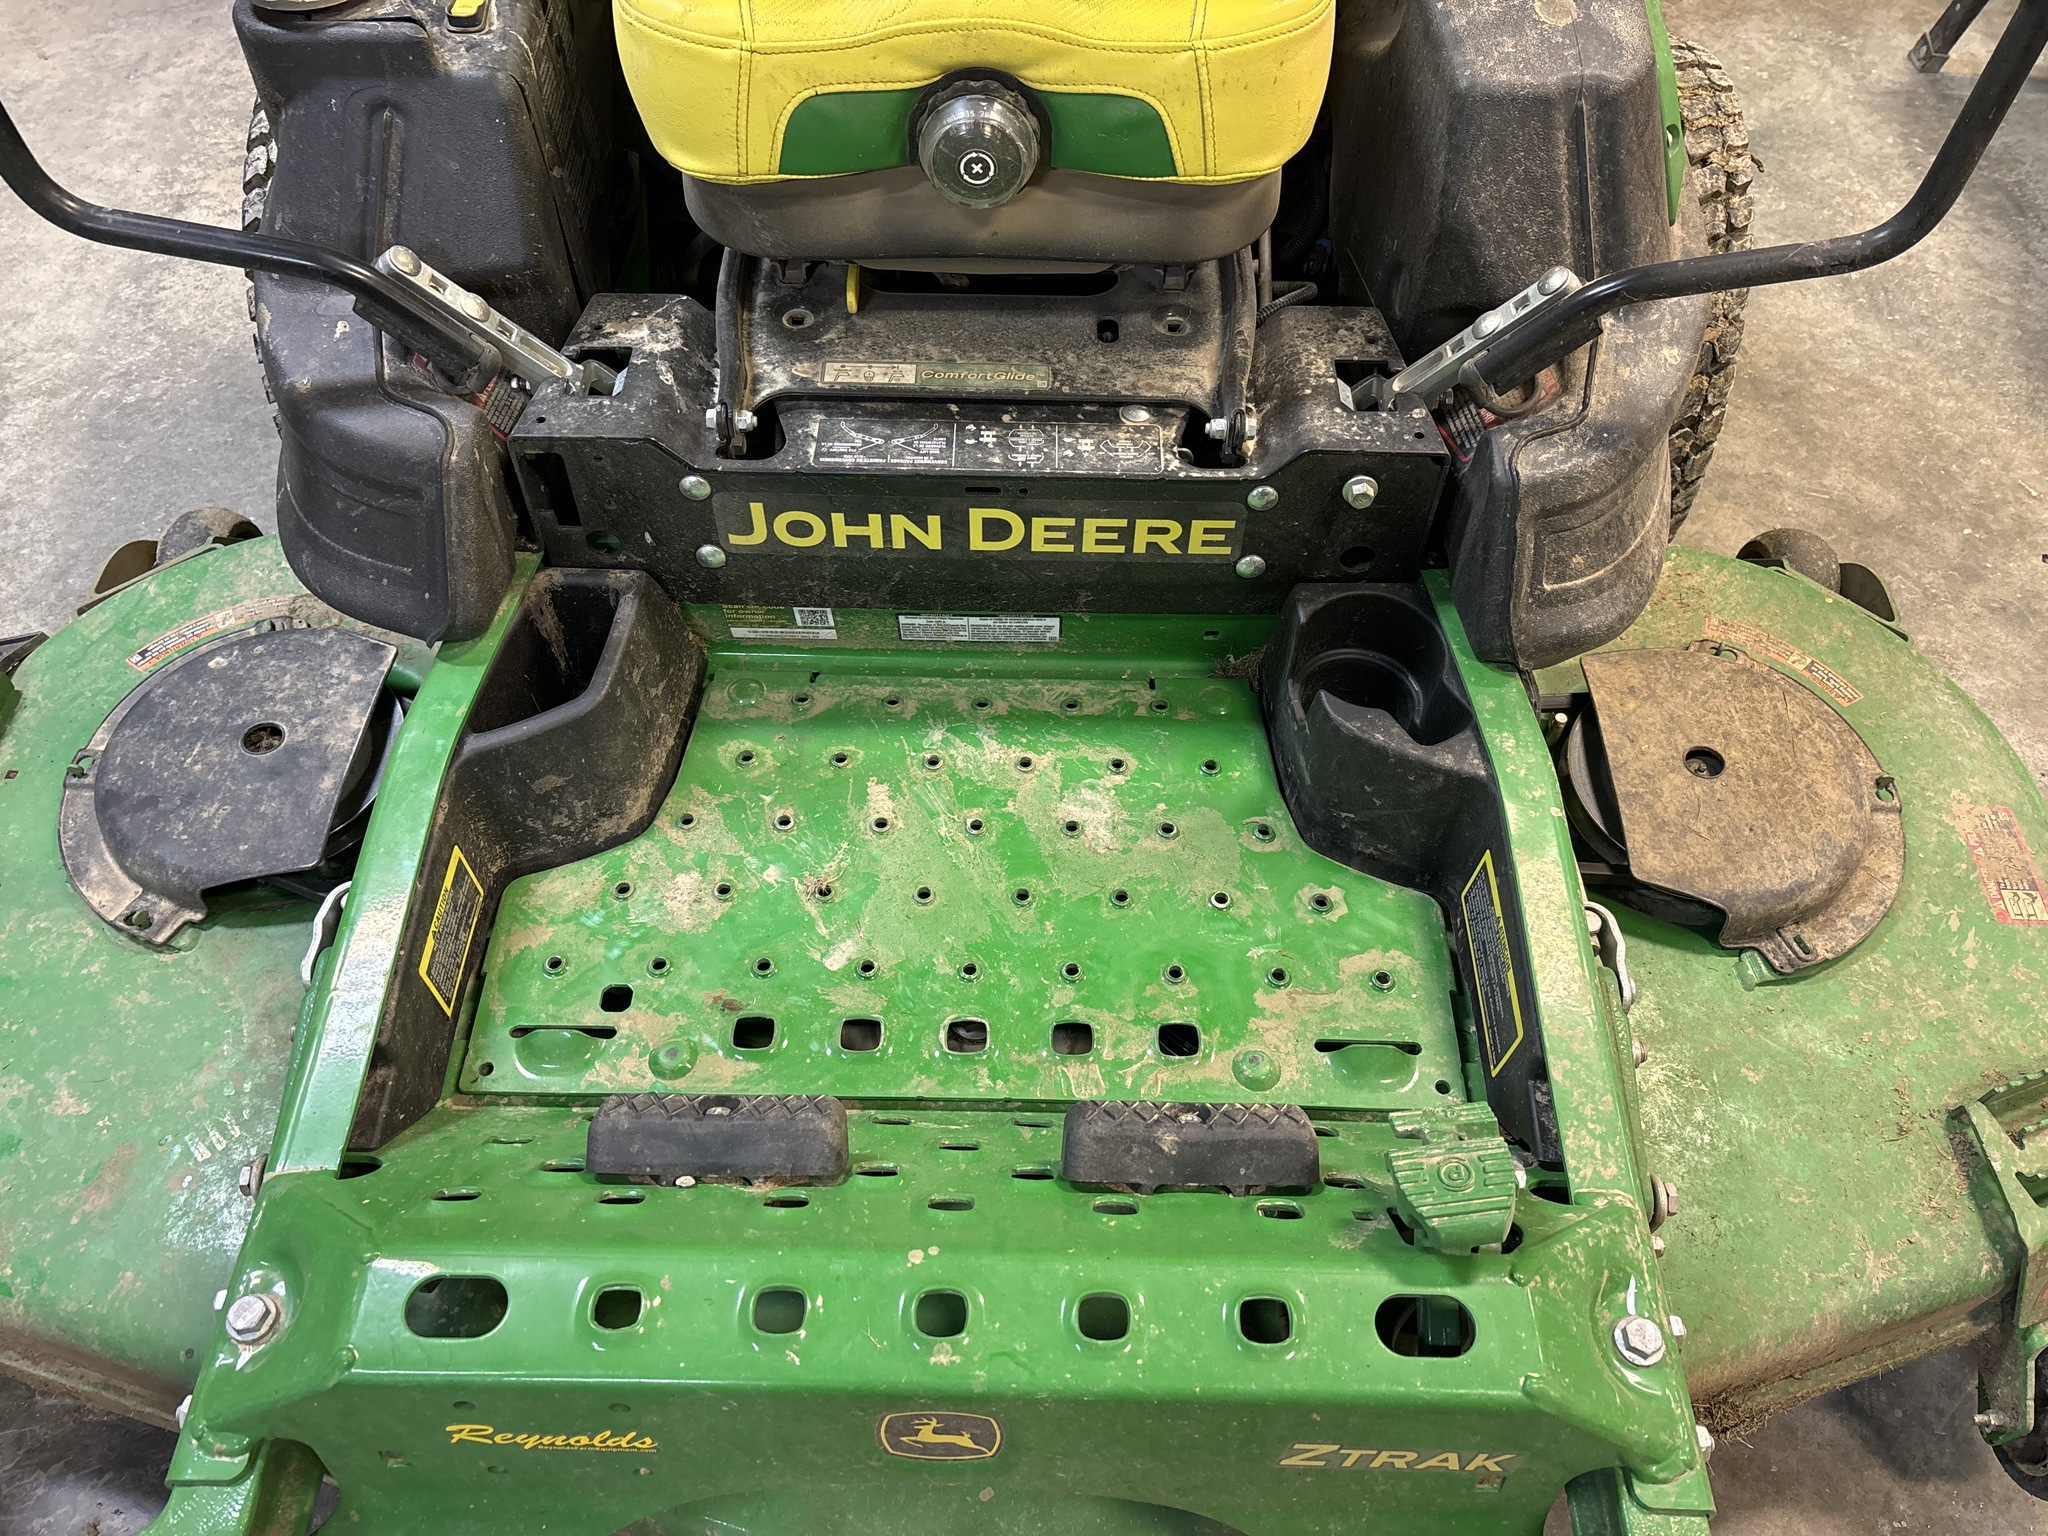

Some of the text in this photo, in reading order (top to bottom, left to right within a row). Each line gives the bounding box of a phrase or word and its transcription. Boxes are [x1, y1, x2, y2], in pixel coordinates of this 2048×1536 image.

[921, 370, 1038, 381] ComfortGlide
[727, 502, 1237, 556] JOHN DEERE
[433, 886, 448, 927] CAUTION
[445, 1424, 659, 1450] Reynolds
[1280, 1443, 1517, 1472] ZTRAK
